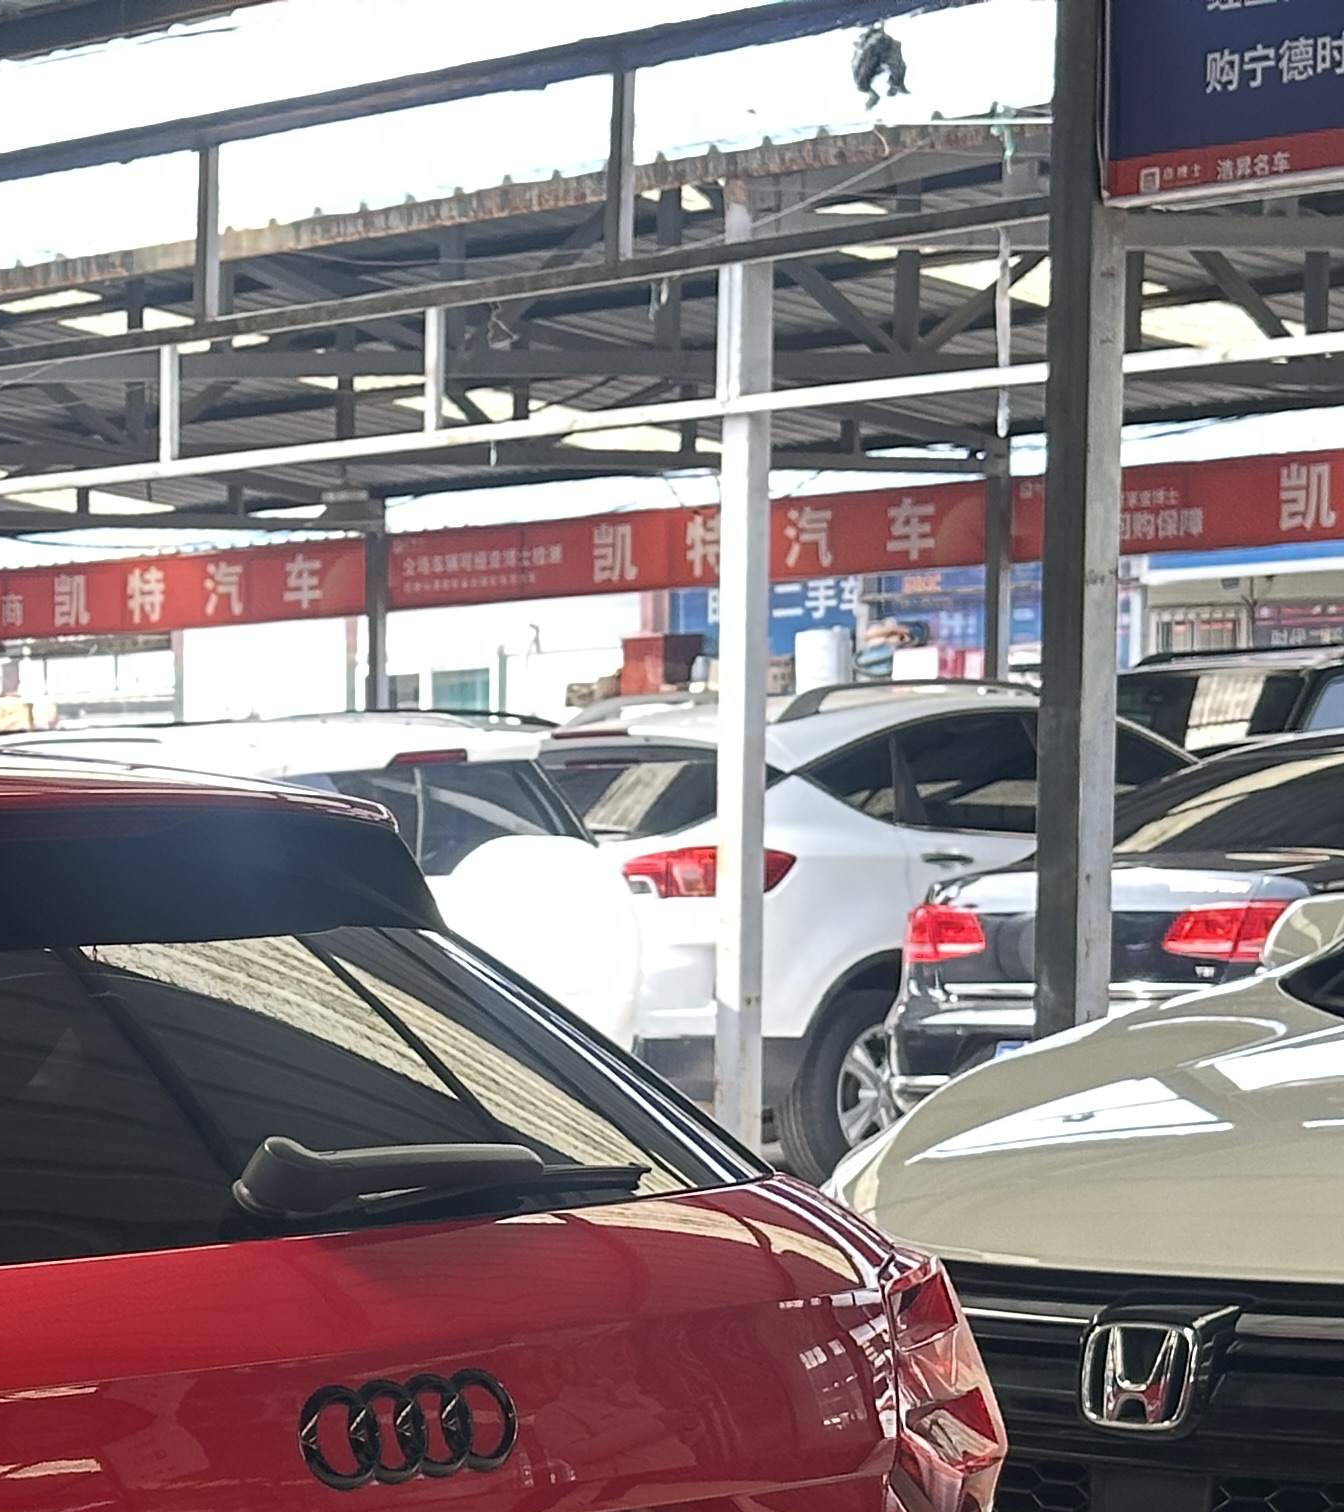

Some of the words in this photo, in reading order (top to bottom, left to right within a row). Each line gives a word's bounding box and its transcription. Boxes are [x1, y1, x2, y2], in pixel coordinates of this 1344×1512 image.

[1279, 462, 1336, 532] 凯
[53, 553, 323, 628] 凯特汽车
